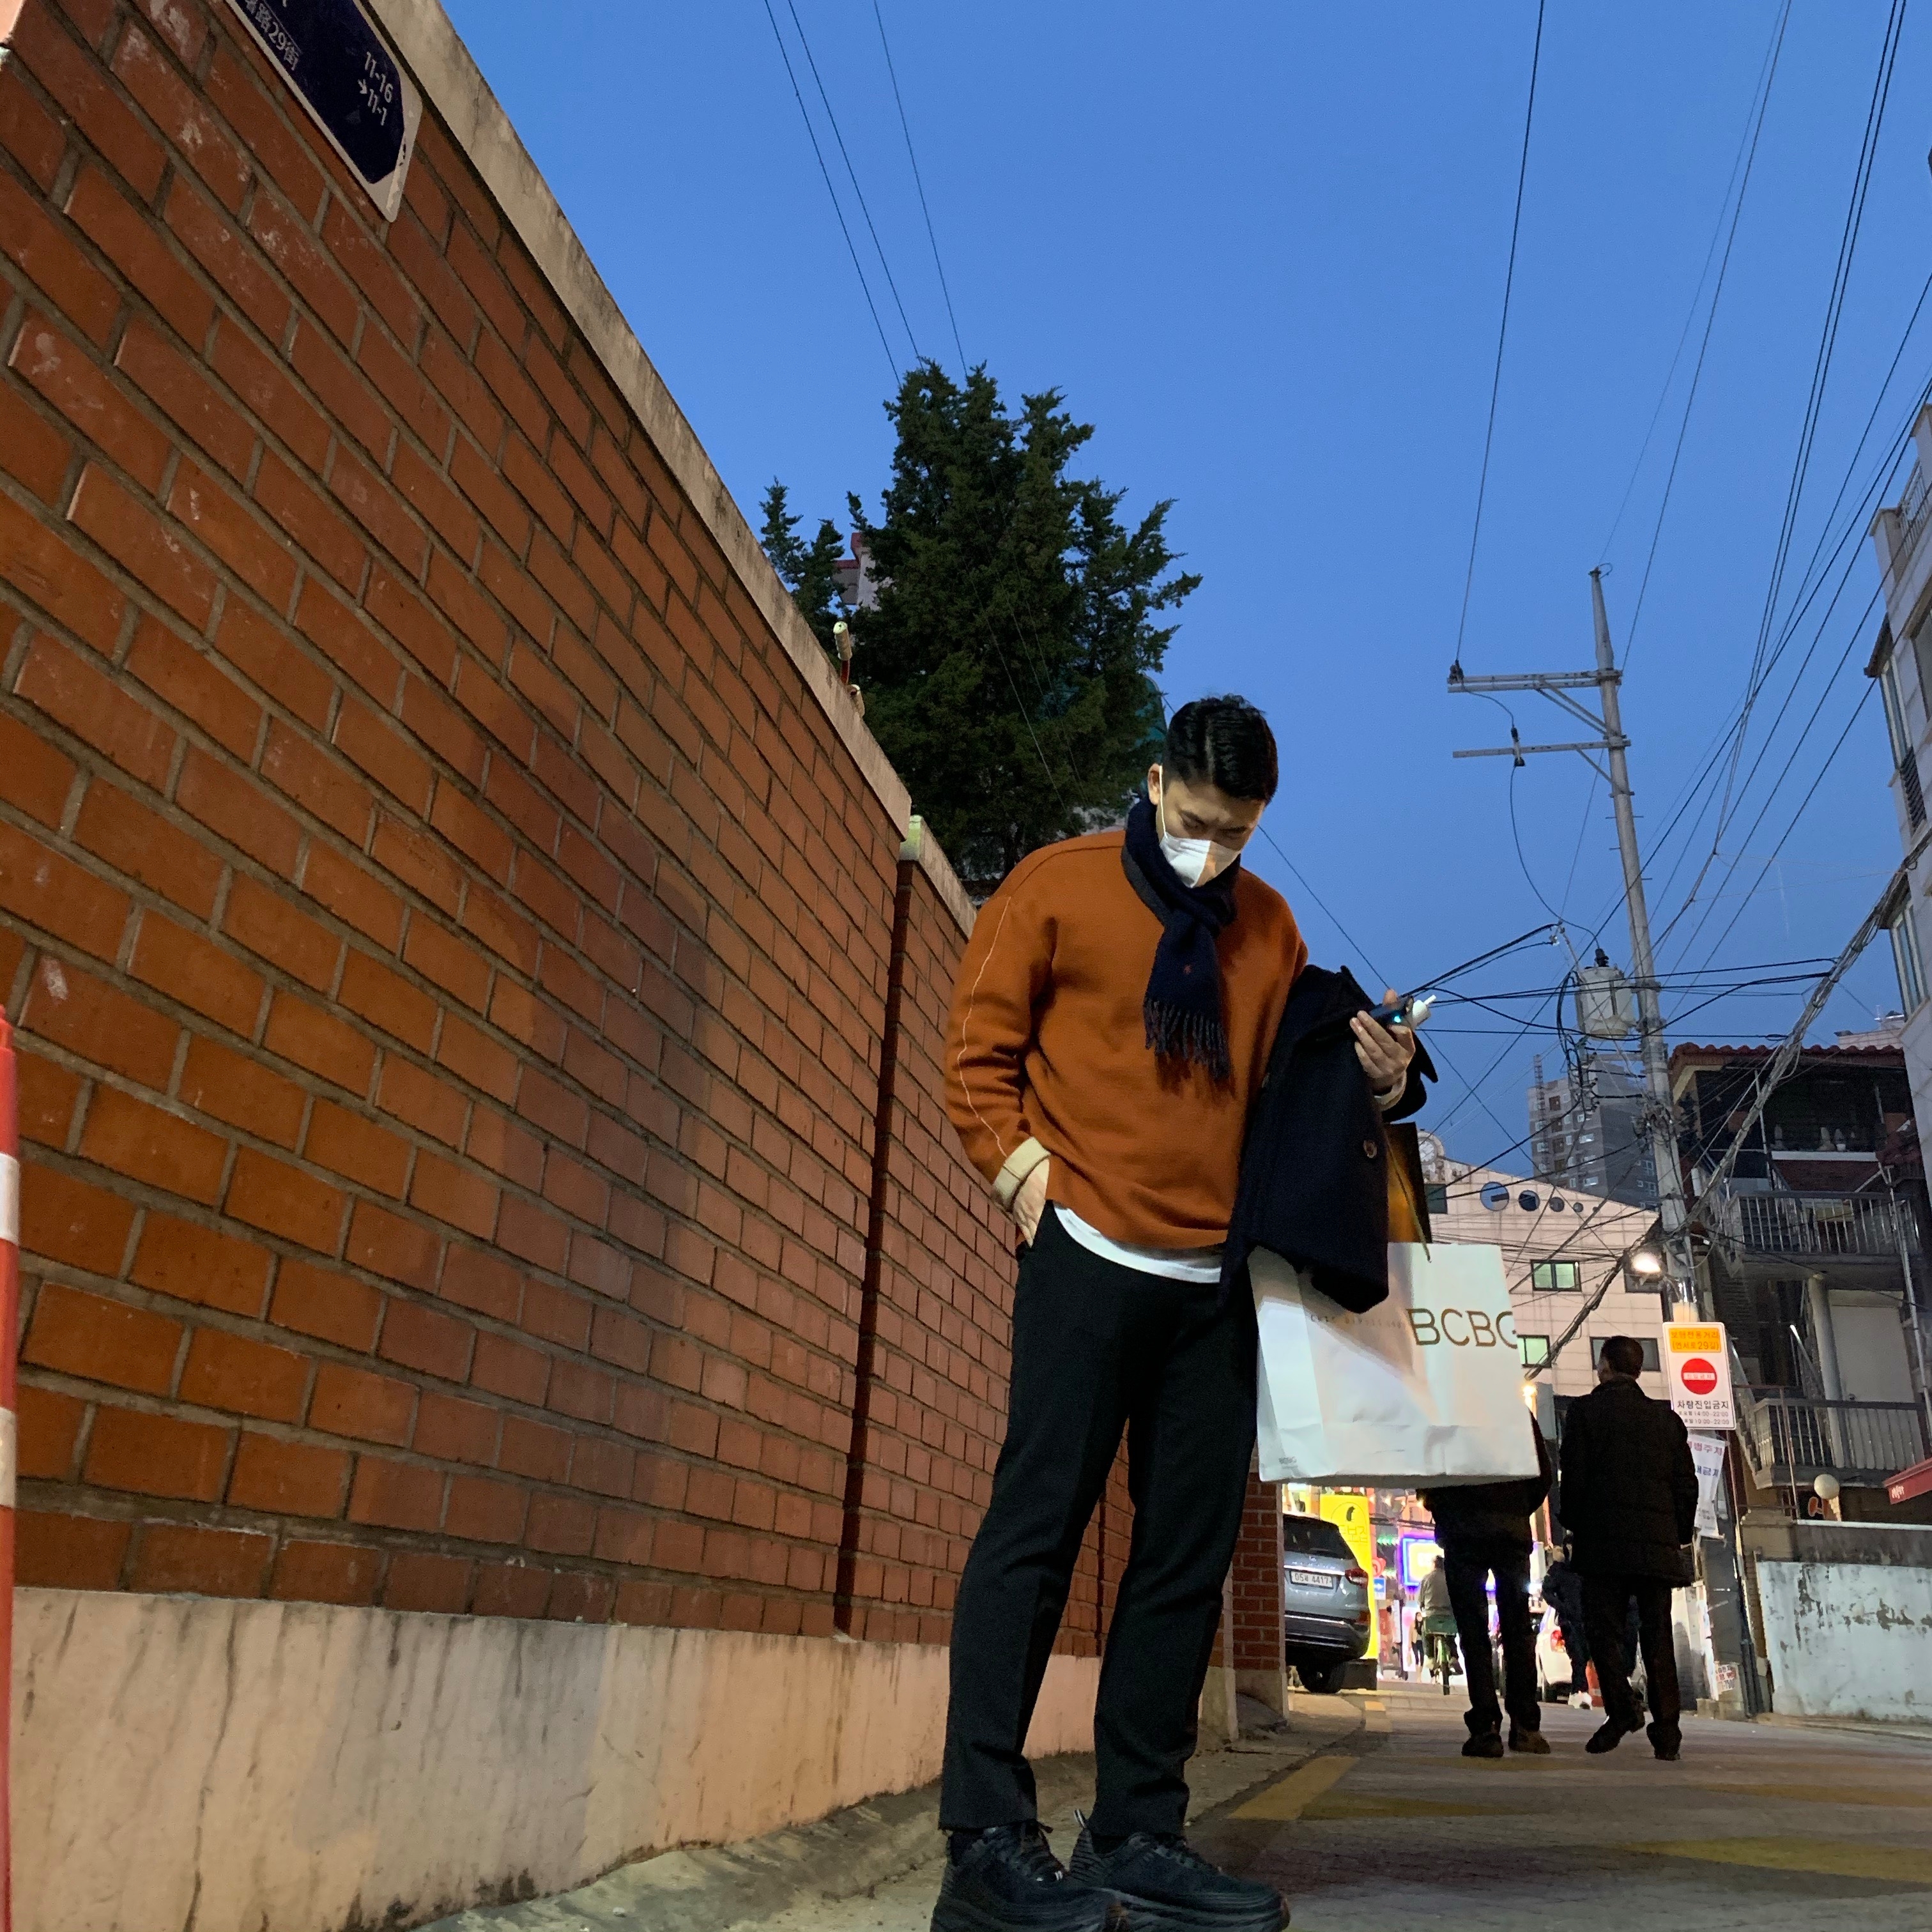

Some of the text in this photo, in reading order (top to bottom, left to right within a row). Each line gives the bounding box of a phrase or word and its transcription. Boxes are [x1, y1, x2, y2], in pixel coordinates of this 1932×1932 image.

[365, 51, 394, 103] 11-16
[367, 89, 387, 126] 11-1
[1671, 1331, 1719, 1339] 보행전용거리
[1677, 1400, 1729, 1409] 차량진입금지
